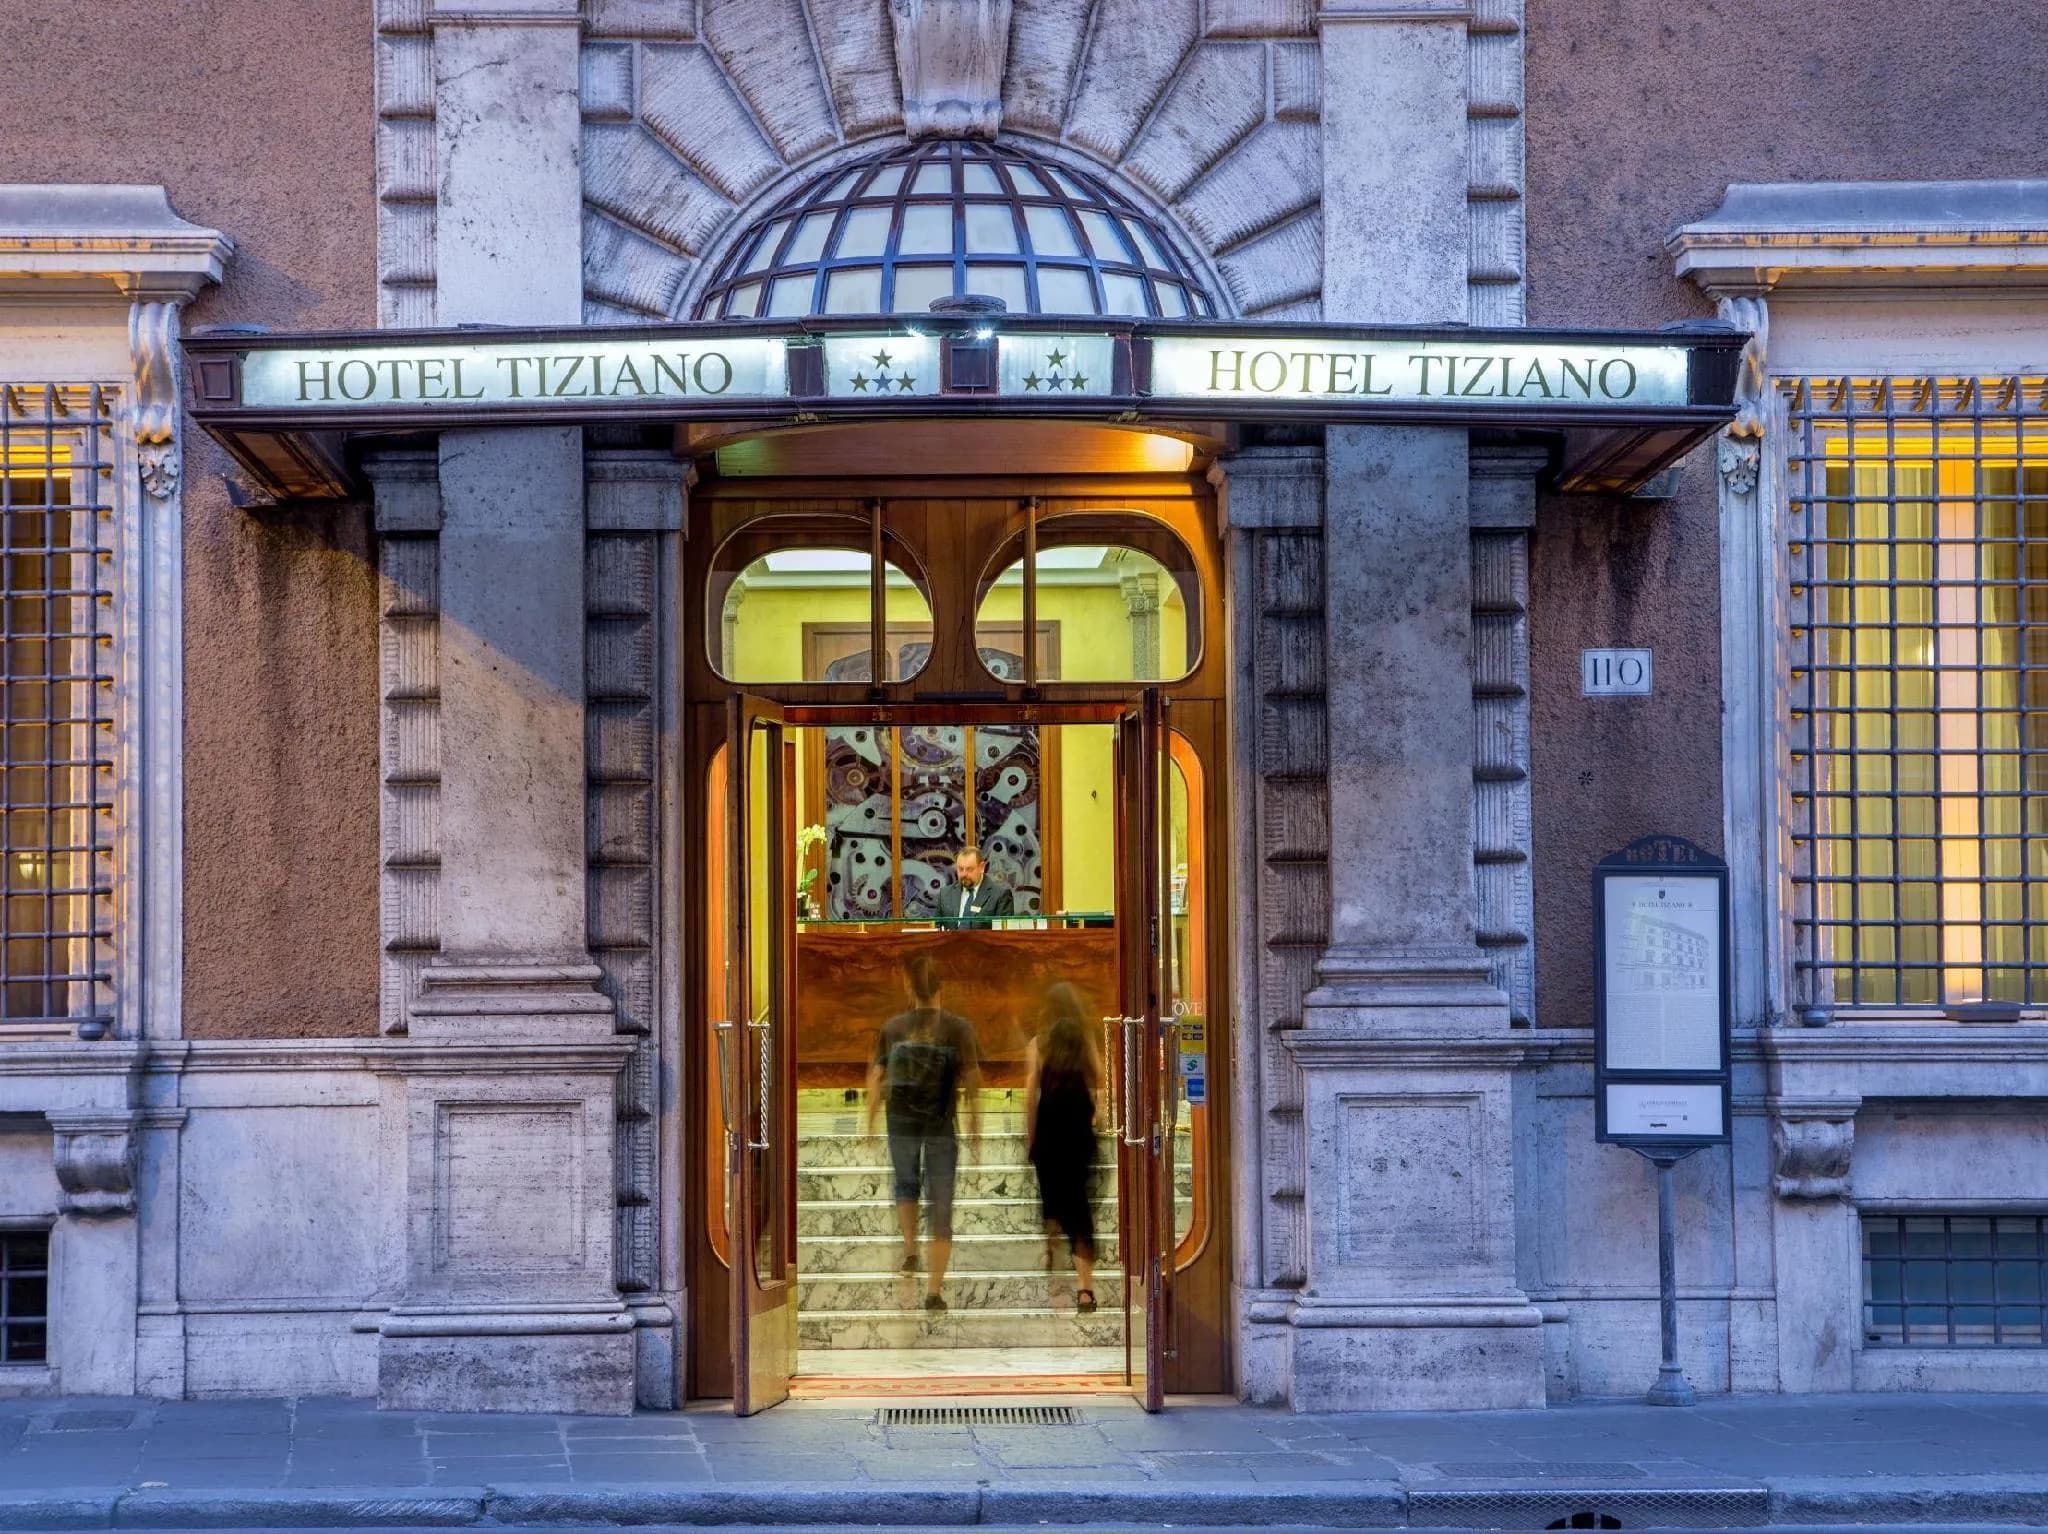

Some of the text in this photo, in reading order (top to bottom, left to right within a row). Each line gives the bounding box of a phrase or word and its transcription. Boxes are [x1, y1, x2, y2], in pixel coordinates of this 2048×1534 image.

[295, 352, 733, 401] HOTEL TIZIANO
[1206, 350, 1637, 400] HOTEL TIZIANO
[1592, 657, 1643, 686] 110
[1626, 839, 1698, 862] HOTEL
